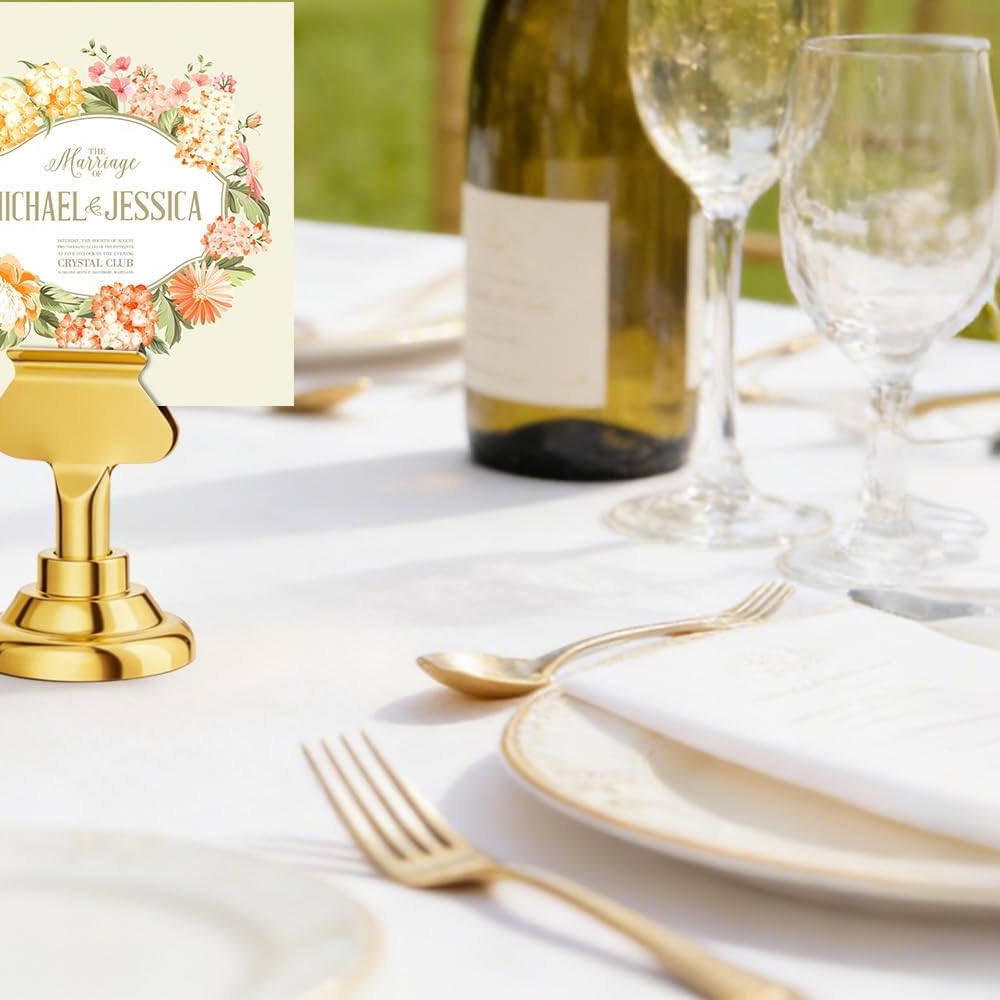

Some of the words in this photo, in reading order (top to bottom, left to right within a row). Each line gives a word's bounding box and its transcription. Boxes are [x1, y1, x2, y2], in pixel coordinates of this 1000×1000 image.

[88, 147, 106, 155] THE
[44, 146, 140, 179] Marriage
[91, 169, 103, 178] OF
[85, 196, 102, 217] &
[104, 190, 202, 222] JESSICA
[57, 258, 104, 268] CRYSTAL
[105, 258, 134, 268] CLUB
